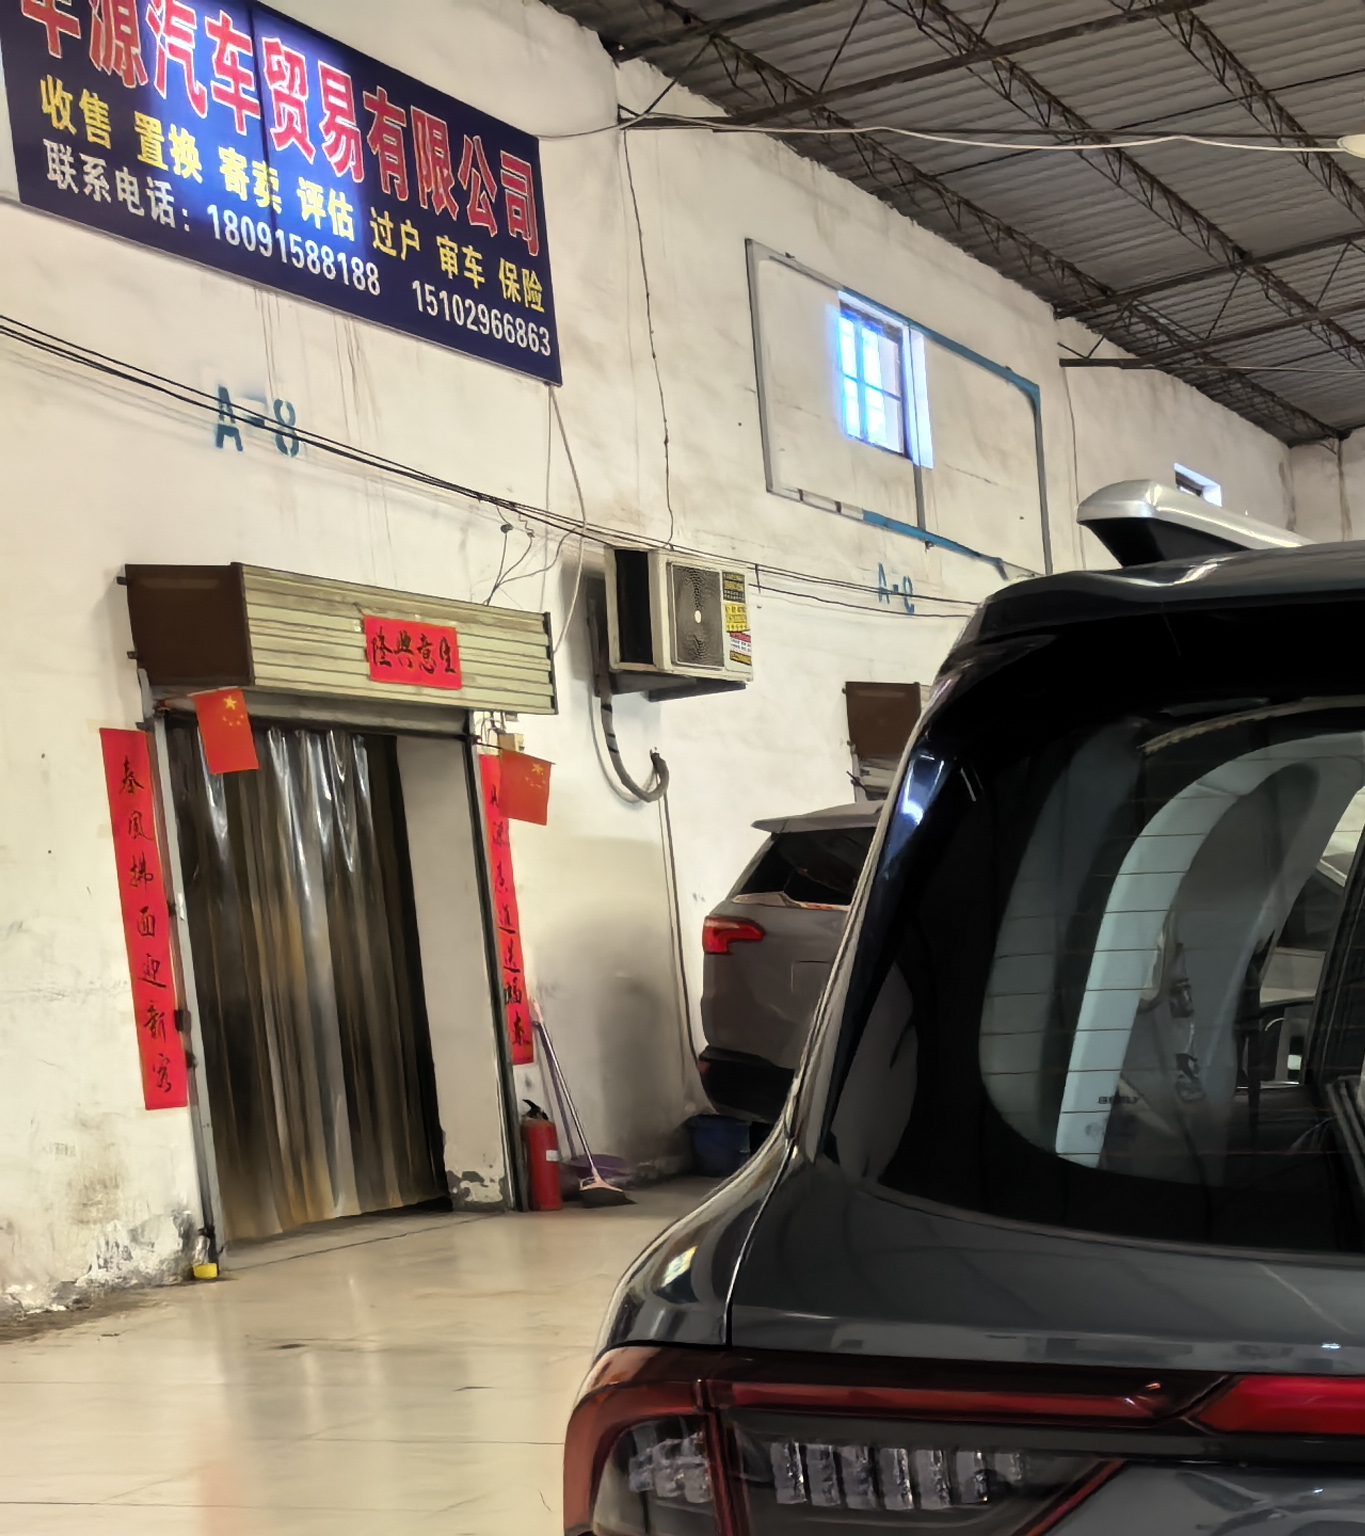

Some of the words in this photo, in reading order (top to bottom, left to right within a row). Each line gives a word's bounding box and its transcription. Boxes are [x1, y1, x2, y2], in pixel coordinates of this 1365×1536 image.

[40, 74, 112, 149] 收售
[134, 110, 203, 184] 置换
[218, 145, 282, 214] 寄卖
[297, 176, 355, 242] 评估
[370, 206, 421, 261] 过户
[436, 234, 486, 289] 审车
[498, 256, 545, 313] 保险
[207, 203, 381, 296] 18091588188
[412, 279, 551, 357] 15102966863
